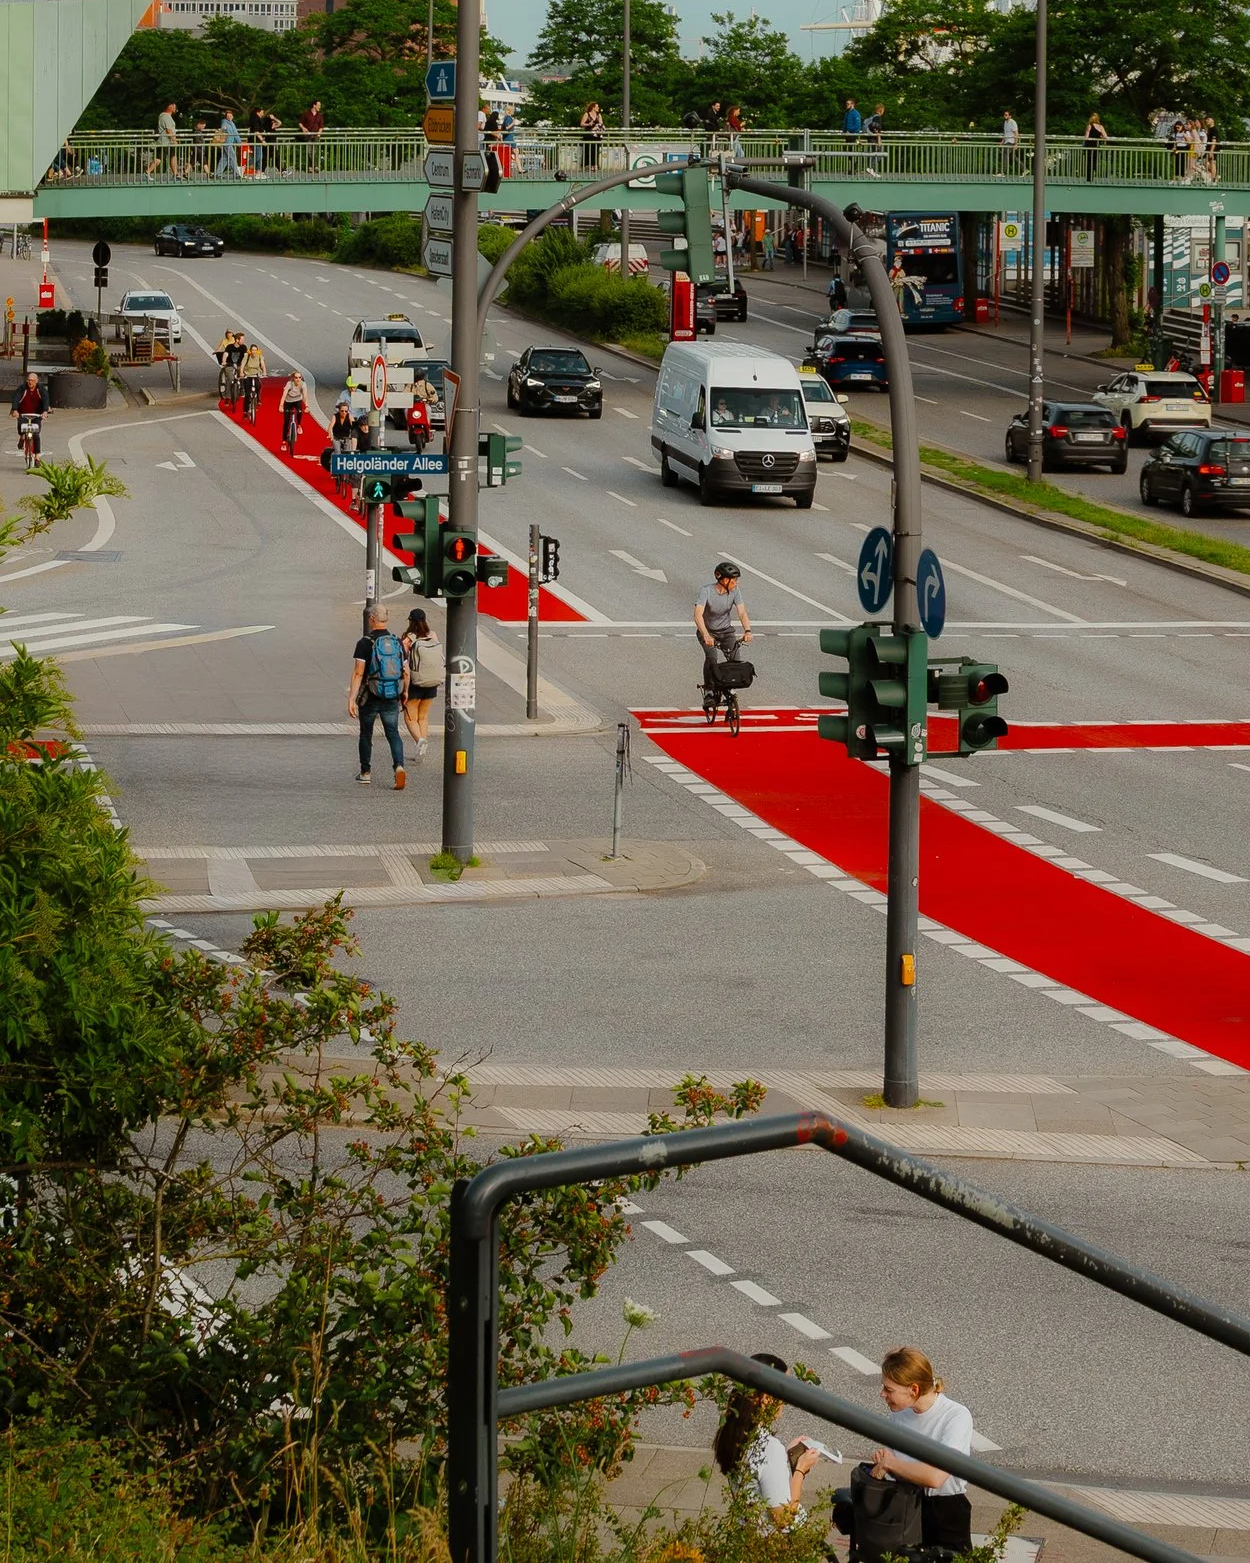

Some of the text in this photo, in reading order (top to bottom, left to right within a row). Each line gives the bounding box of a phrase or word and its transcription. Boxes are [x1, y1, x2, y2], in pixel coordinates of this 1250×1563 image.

[919, 222, 951, 233] TITANIC
[337, 457, 443, 474] Helgoländer Allee
